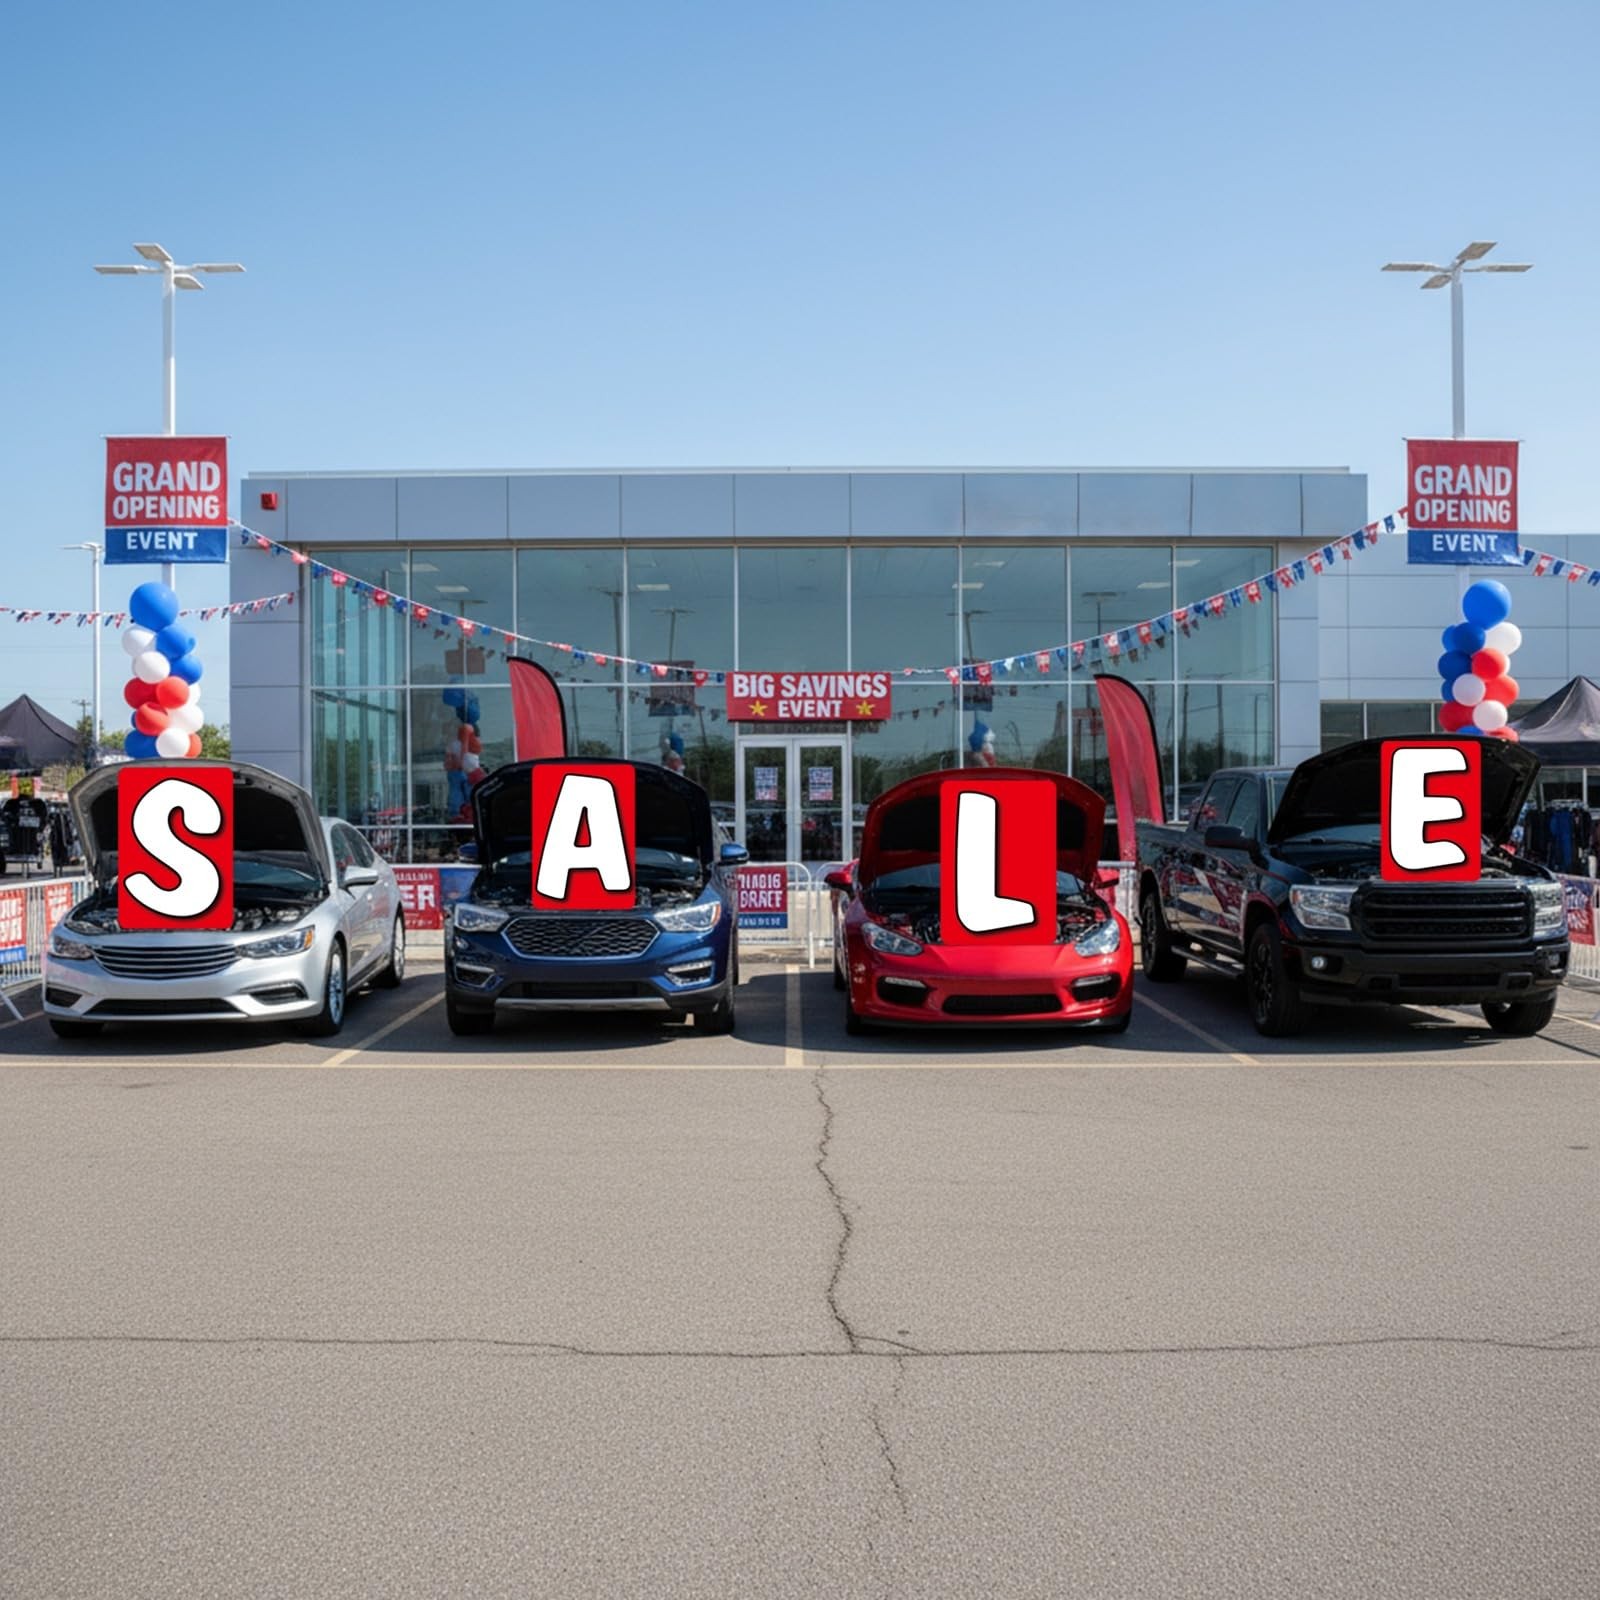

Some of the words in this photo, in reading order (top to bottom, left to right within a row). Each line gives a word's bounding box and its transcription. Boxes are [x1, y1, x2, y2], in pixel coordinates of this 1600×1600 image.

[113, 461, 221, 492] GRAND
[1414, 464, 1513, 496] GRAND
[112, 495, 220, 519] OPENING
[1414, 498, 1511, 524] OPENING
[126, 531, 198, 550] EVENT
[1432, 534, 1498, 552] EVENT
[733, 674, 775, 698] BIG
[780, 674, 888, 698] SAVINGS
[778, 700, 842, 718] EVENT
